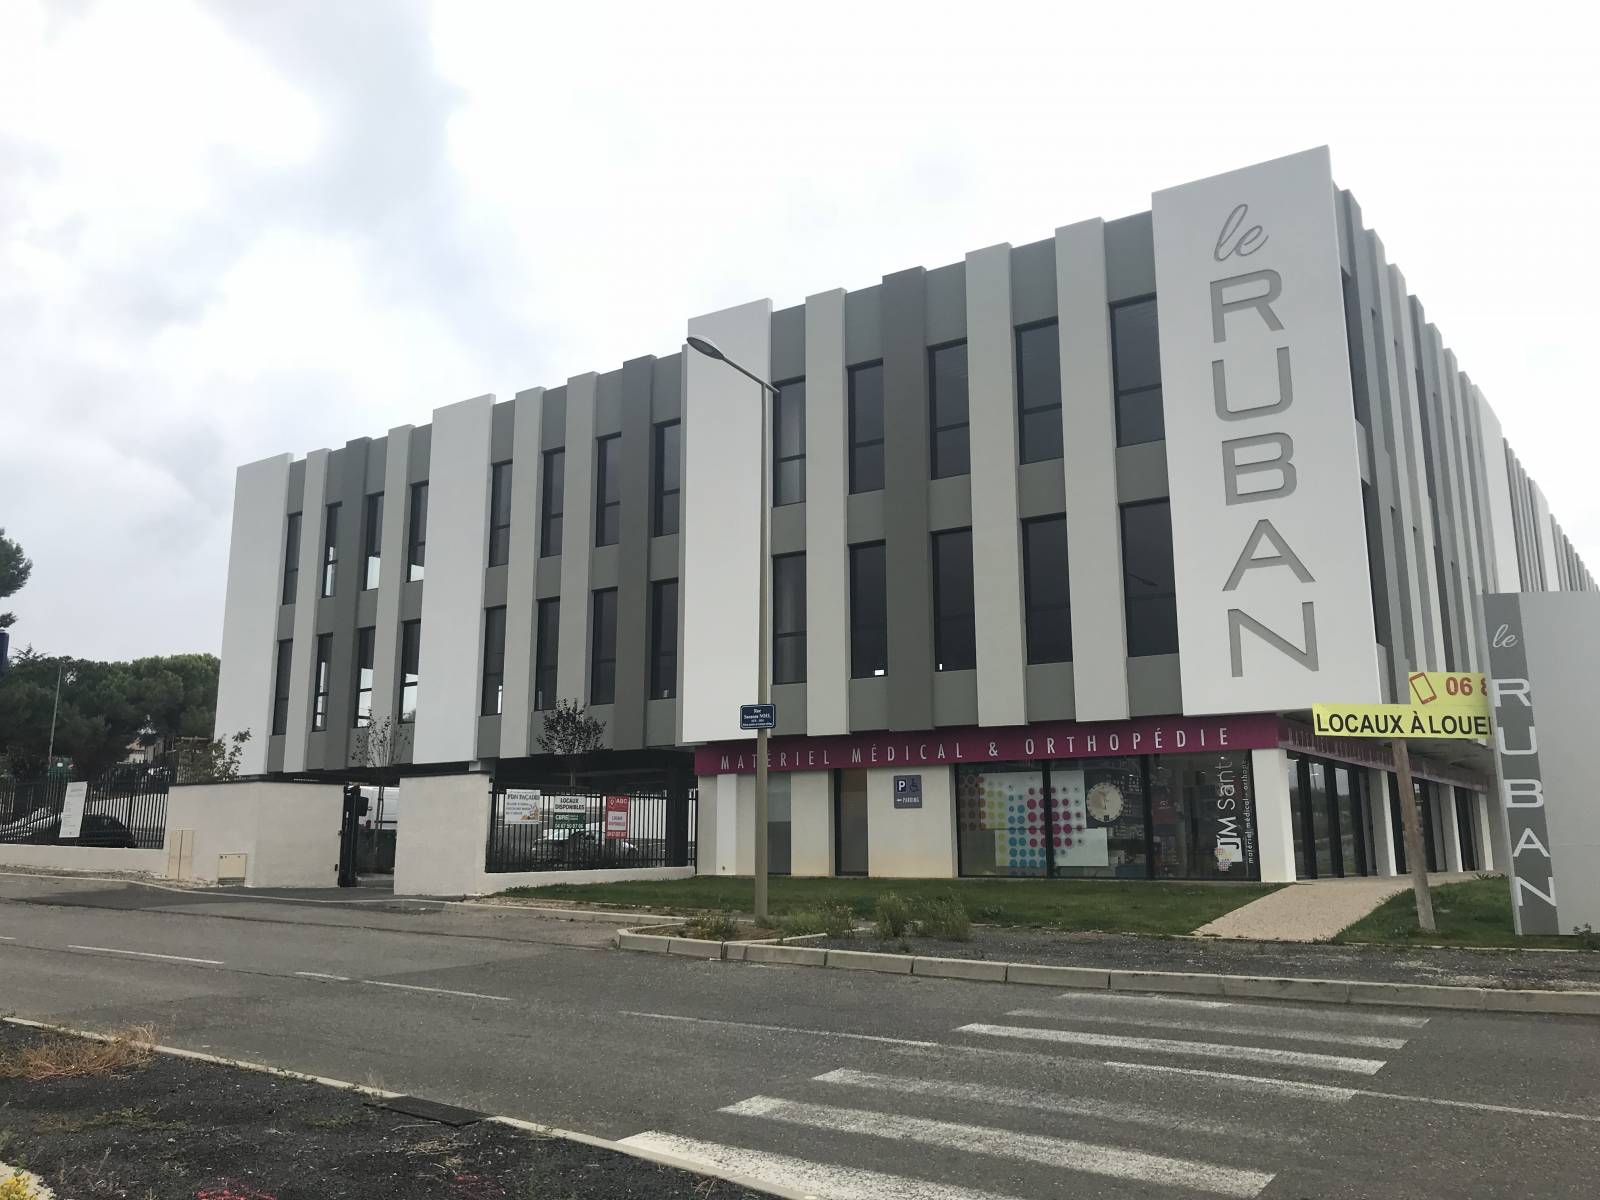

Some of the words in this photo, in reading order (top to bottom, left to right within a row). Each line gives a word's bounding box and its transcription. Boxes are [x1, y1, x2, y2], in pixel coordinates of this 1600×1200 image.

[1214, 203, 1269, 262] le
[1209, 268, 1320, 678] RUBAN
[1492, 623, 1519, 649] le
[1445, 676, 1473, 697] 06
[1316, 713, 1405, 735] LOCAUX
[1410, 710, 1426, 734] À
[1429, 715, 1492, 736] LOUE
[851, 742, 963, 764] MÉDICAL
[988, 741, 999, 757] &
[1025, 727, 1229, 756] ORTHOPÉDIE
[898, 780, 906, 791] P
[1215, 755, 1236, 811] Sant
[1491, 678, 1558, 907] RUBAN
